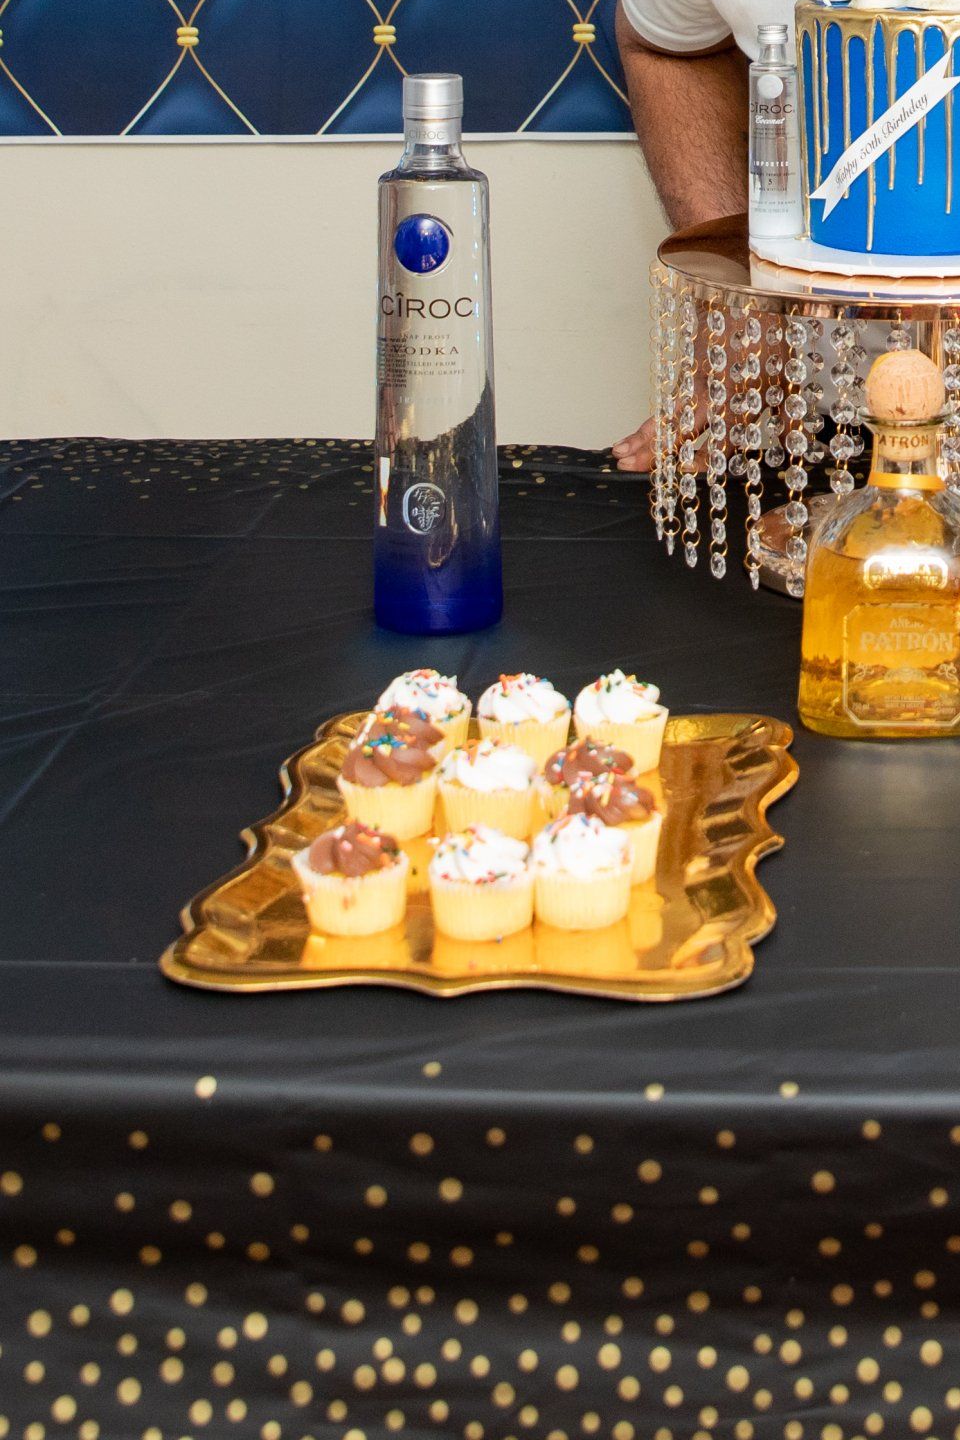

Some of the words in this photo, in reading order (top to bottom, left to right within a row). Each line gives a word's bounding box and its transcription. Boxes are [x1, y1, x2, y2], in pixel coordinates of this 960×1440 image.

[859, 133, 881, 160] 50th
[881, 93, 929, 139] Birthday
[878, 432, 930, 449] ATRÓN
[860, 627, 955, 653] PATRÓN
